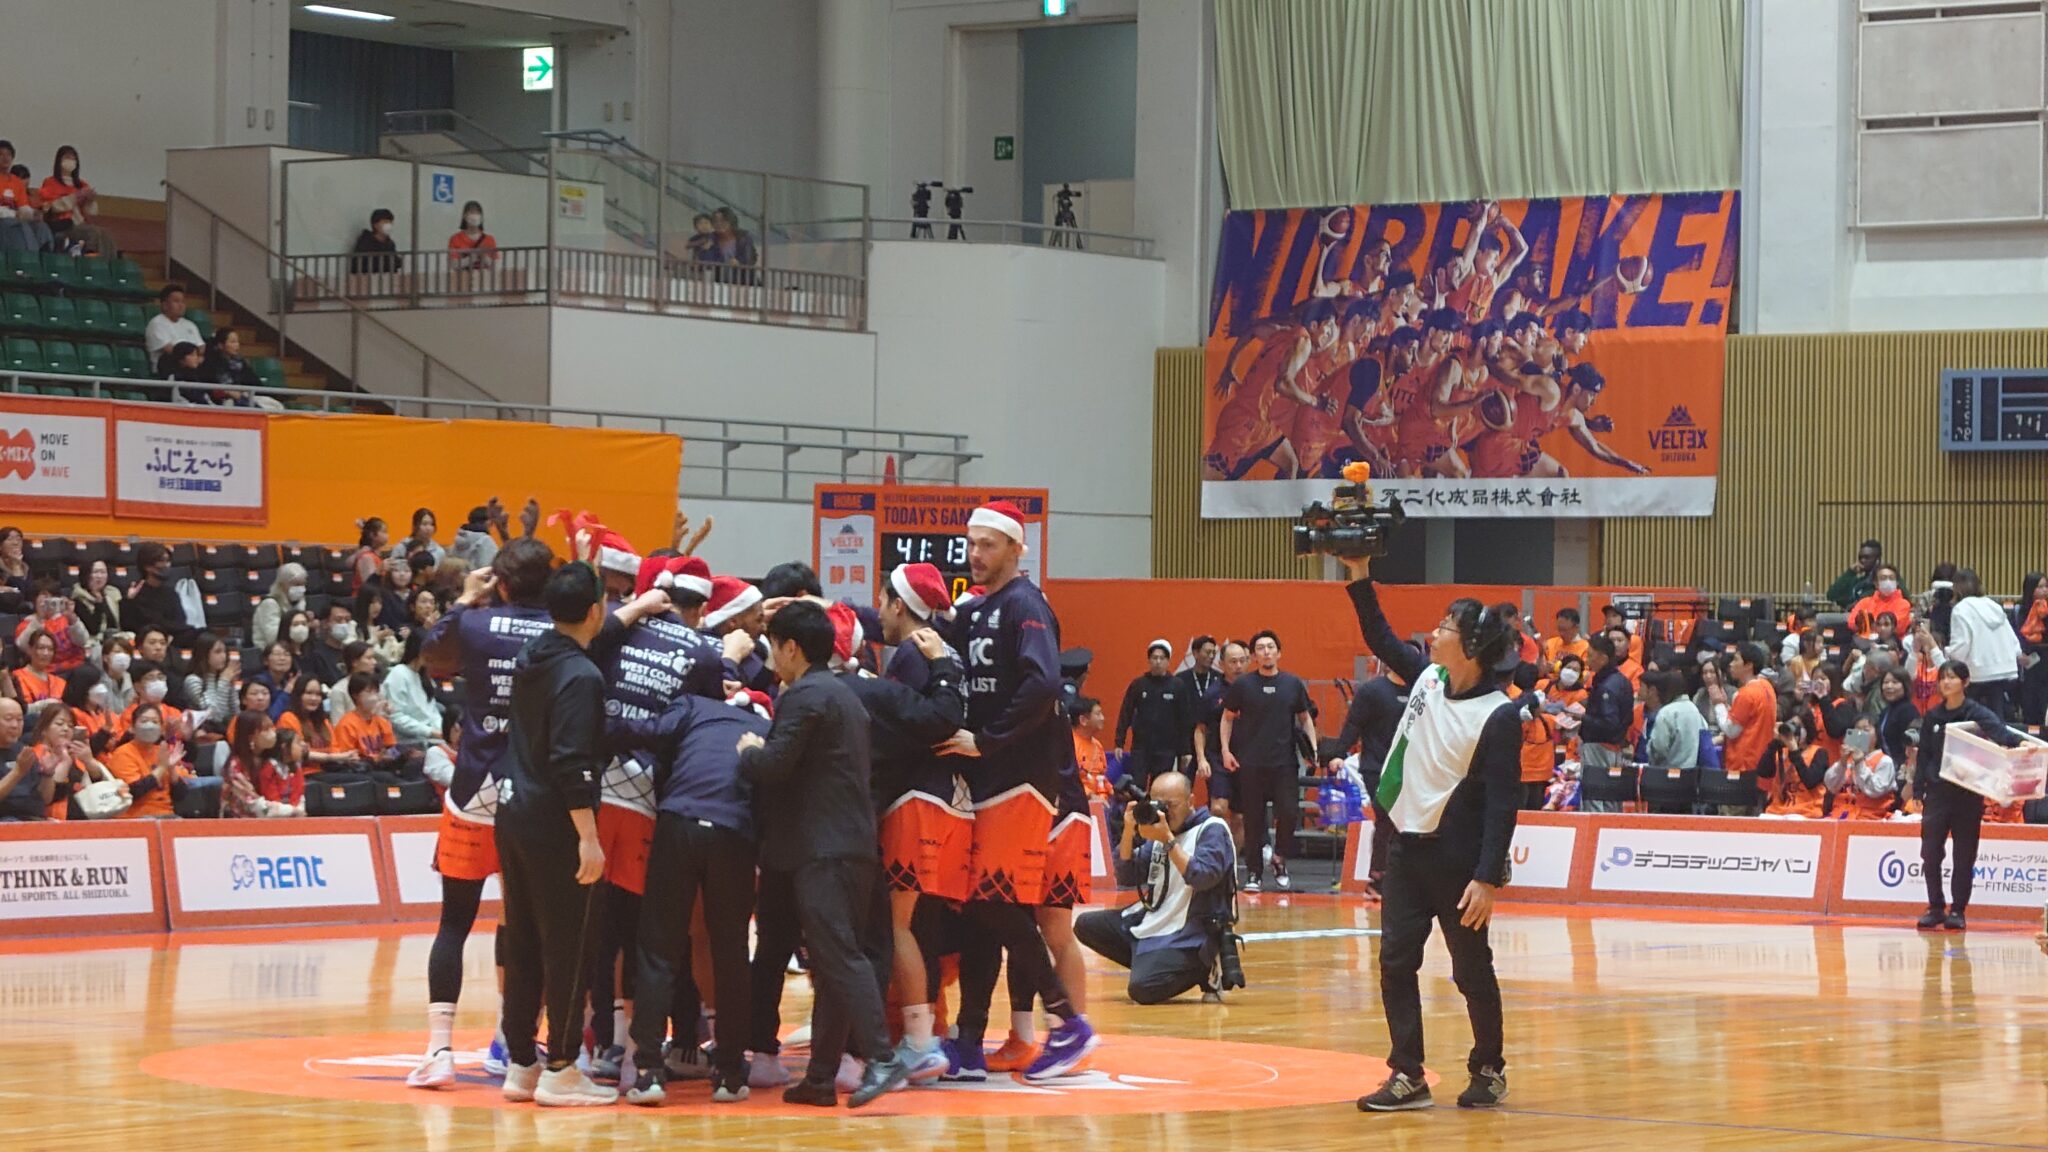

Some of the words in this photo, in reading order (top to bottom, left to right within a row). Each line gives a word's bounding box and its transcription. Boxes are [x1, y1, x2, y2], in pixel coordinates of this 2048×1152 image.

[40, 433, 69, 446] MOVE
[40, 449, 56, 461] ON
[1661, 452, 1696, 462] SHIZUOKA
[41, 466, 71, 478] WAVE
[884, 506, 938, 526] TODAY'S
[620, 659, 648, 674] WEST
[649, 668, 684, 690] COAST
[624, 672, 673, 695] BREWING
[1972, 867, 1998, 881] MY
[2004, 866, 2048, 882] PACE
[1984, 881, 2033, 893] FITNESS
[1, 892, 19, 903] ALL
[63, 890, 80, 900] ALL
